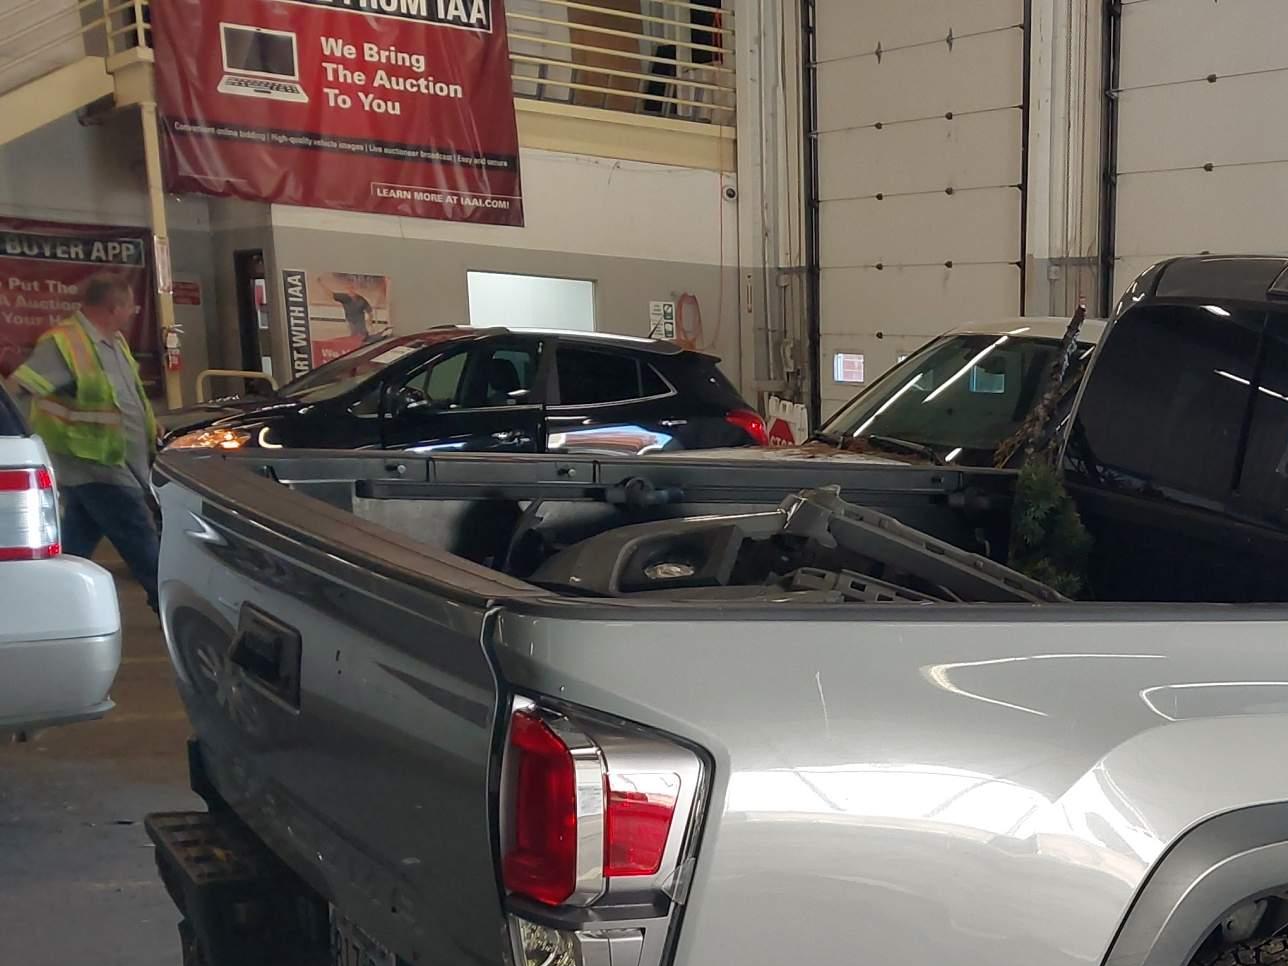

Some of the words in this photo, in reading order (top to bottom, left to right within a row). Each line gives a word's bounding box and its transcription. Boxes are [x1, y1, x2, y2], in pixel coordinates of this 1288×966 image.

[436, 0, 487, 25] IAA
[320, 36, 357, 59] We
[363, 42, 426, 73] Bring
[321, 62, 366, 85] The
[373, 70, 463, 98] Auction
[323, 88, 352, 109] To
[357, 92, 401, 115] You
[376, 187, 412, 200] LEARN
[414, 191, 443, 204] MORE
[444, 194, 459, 205] AT
[5, 236, 84, 259] BUYER
[90, 241, 136, 262] APP
[8, 277, 40, 292] Put
[45, 279, 80, 294] The
[287, 273, 304, 302] IAA
[15, 295, 82, 311] Auction
[2, 311, 43, 326] Your
[289, 306, 308, 348] WITH
